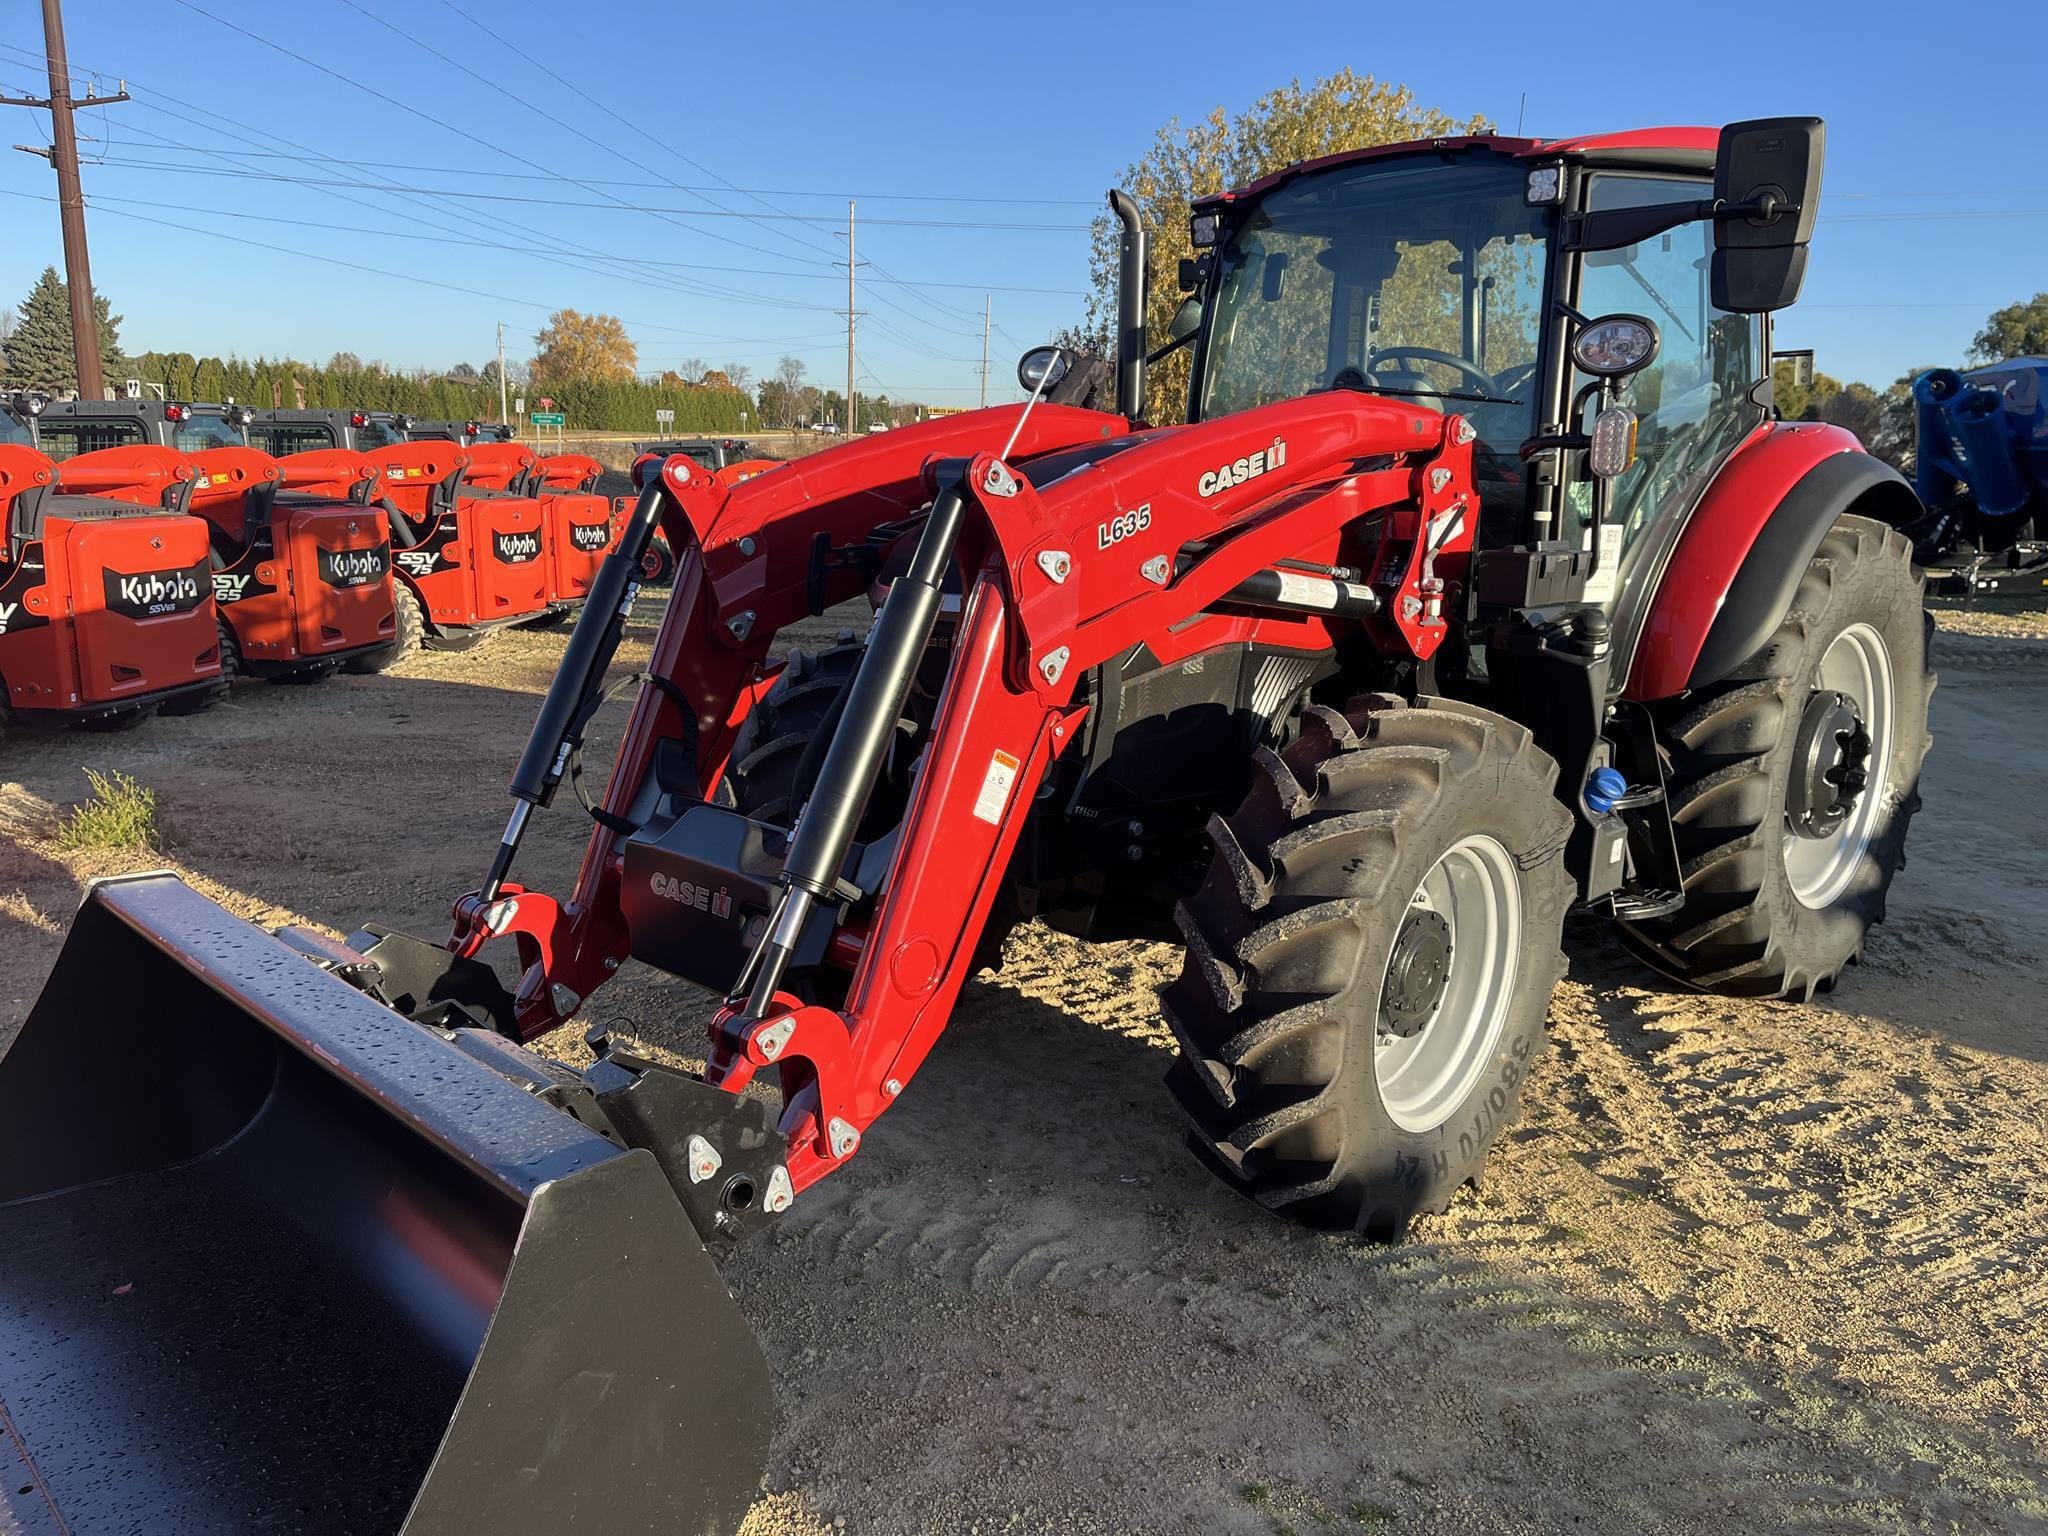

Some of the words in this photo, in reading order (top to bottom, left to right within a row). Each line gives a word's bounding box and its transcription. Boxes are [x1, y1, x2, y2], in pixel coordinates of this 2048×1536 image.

[1198, 451, 1264, 498] CASE
[575, 526, 605, 544] Kubota
[1099, 504, 1151, 550] L635
[500, 534, 536, 555] Kubota
[329, 551, 382, 577] Kubota
[397, 552, 440, 565] SSV
[411, 564, 433, 575] 75
[120, 571, 198, 605] Kubota
[215, 588, 242, 601] 65
[149, 603, 176, 614] SSV65
[650, 872, 710, 912] CASE
[1458, 1035, 1530, 1164] 380/70
